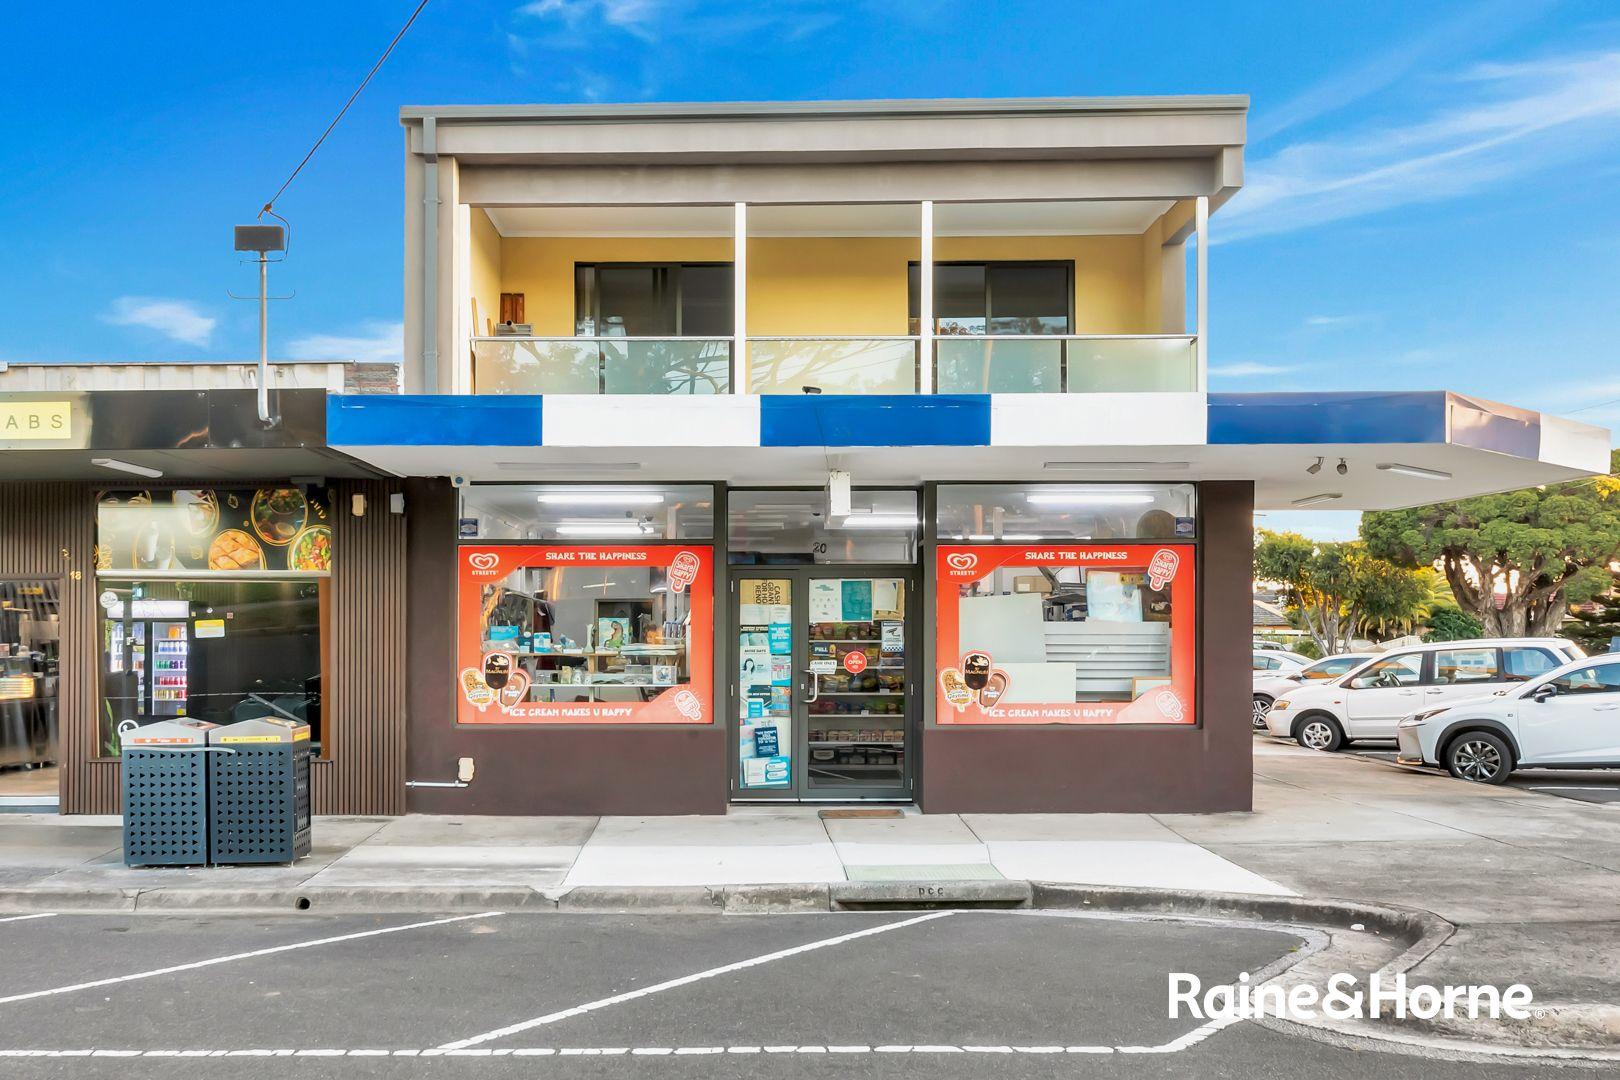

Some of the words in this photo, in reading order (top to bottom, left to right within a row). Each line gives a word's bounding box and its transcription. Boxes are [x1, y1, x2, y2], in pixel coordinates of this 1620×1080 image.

[812, 542, 827, 554] 20
[545, 552, 575, 560] SHARE
[578, 552, 597, 560] THE
[599, 552, 647, 560] HAPPINESS
[1025, 551, 1055, 560] SHARE
[1057, 551, 1077, 560] THE
[1079, 551, 1128, 560] HAPPINESS
[70, 570, 82, 580] 18
[510, 708, 526, 717] ICE
[528, 708, 559, 717] CREAM
[561, 708, 591, 717] MAKES
[602, 708, 633, 717] HAPPY
[989, 709, 1006, 717] ICE
[1007, 708, 1039, 717] CREAM
[1041, 708, 1072, 717] MAKES
[1074, 709, 1080, 717] U
[1082, 708, 1113, 717] HAPPY
